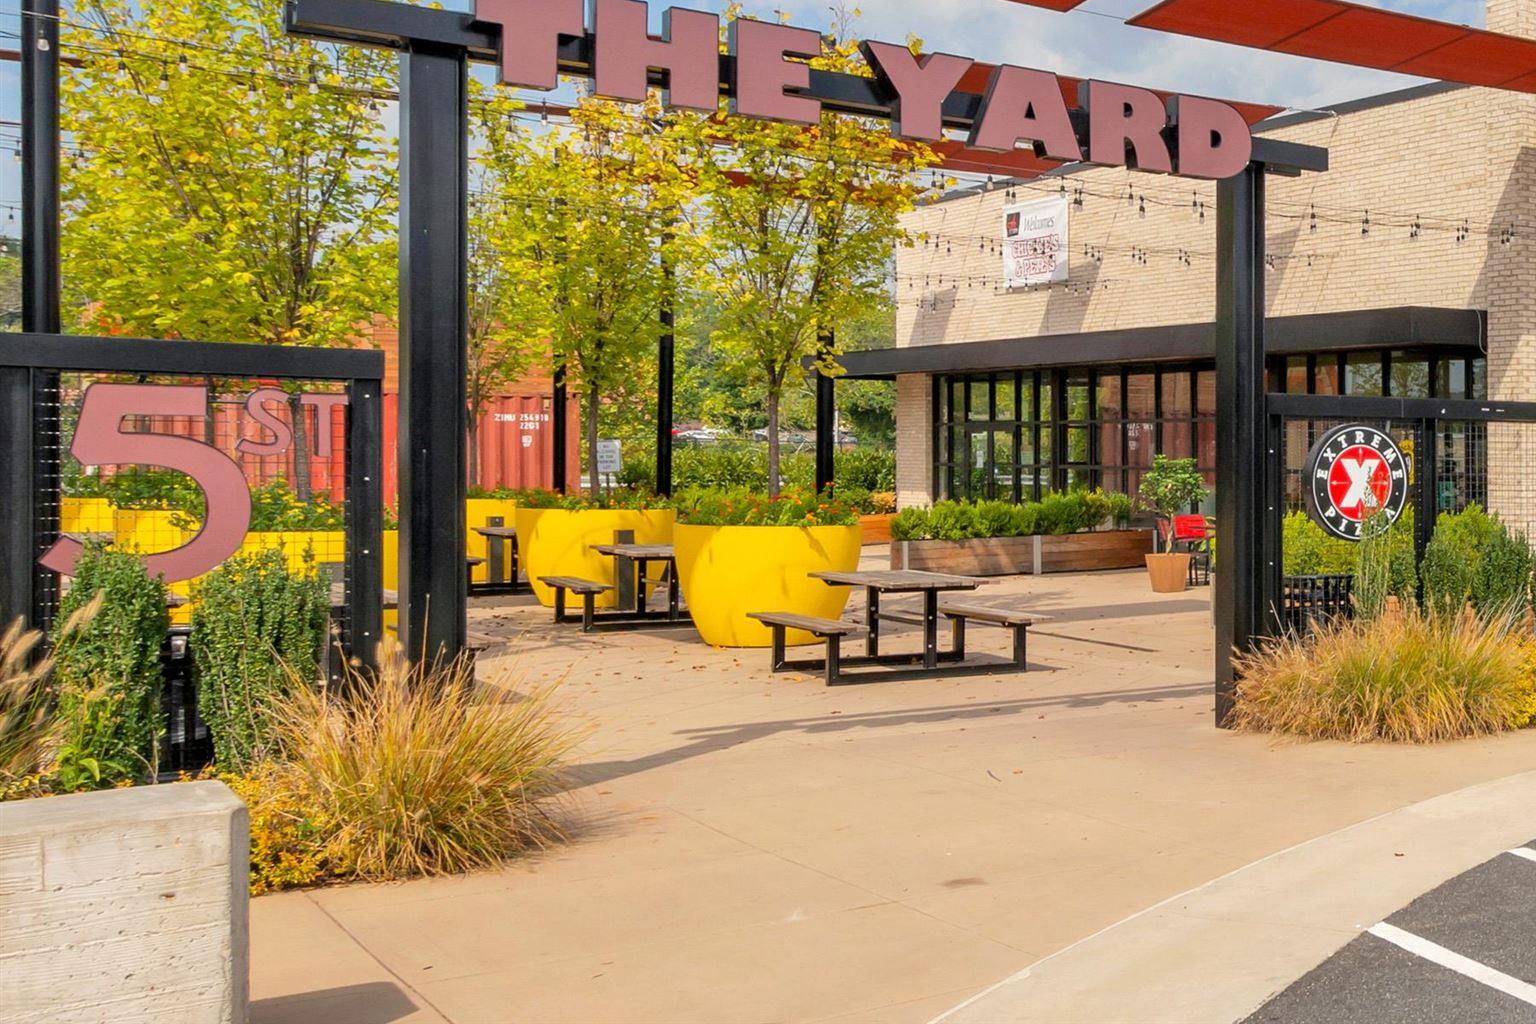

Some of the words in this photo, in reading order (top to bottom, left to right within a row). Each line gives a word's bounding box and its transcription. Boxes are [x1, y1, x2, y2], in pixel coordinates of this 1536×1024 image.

[858, 39, 1253, 179] YARD
[1316, 431, 1403, 480] EXTREME
[1324, 505, 1396, 536] PIZA
